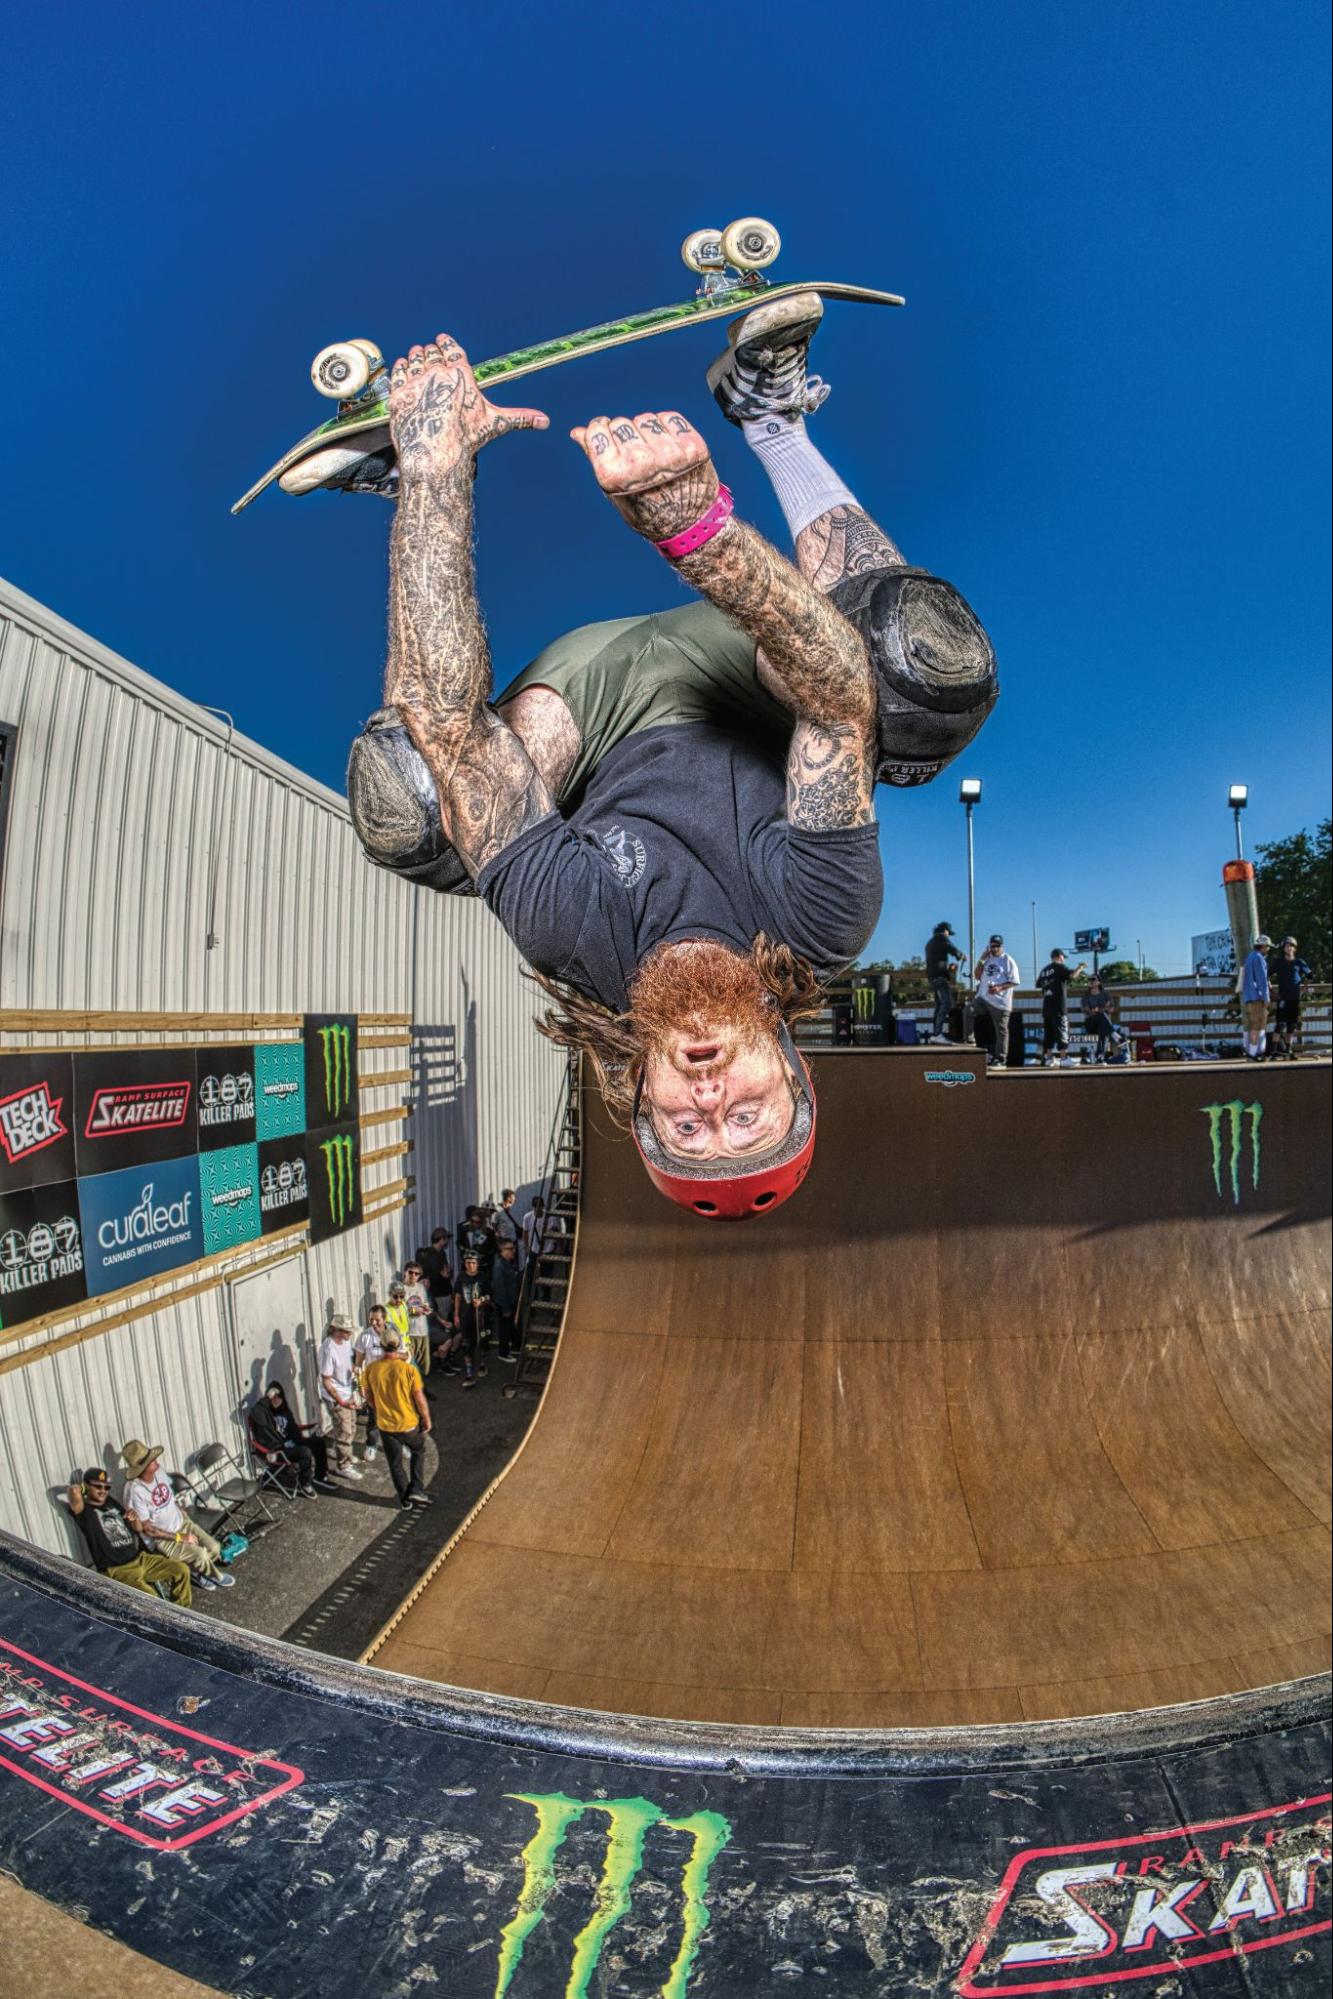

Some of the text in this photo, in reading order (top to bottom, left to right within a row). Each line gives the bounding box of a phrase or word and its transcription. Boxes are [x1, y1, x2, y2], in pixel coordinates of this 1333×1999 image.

[115, 1089, 185, 1103] RAMP SURFACE
[201, 1073, 253, 1106] 187
[263, 1082, 298, 1094] weedmaps
[0, 1089, 48, 1134] TECH
[92, 1096, 185, 1129] SKATELITE
[200, 1102, 255, 1126] KILLER PADS
[8, 1108, 61, 1154] DECK
[261, 1159, 306, 1194] 187
[212, 1186, 252, 1206] weedmaps
[260, 1190, 289, 1211] KILLER
[98, 1187, 192, 1249] curaleaf
[0, 1218, 79, 1269] 187
[103, 1230, 192, 1267] CANNABIS WITH CONFIDENCE
[0, 1250, 83, 1295] KILLER PADS
[1139, 1829, 1287, 1877] RAMP
